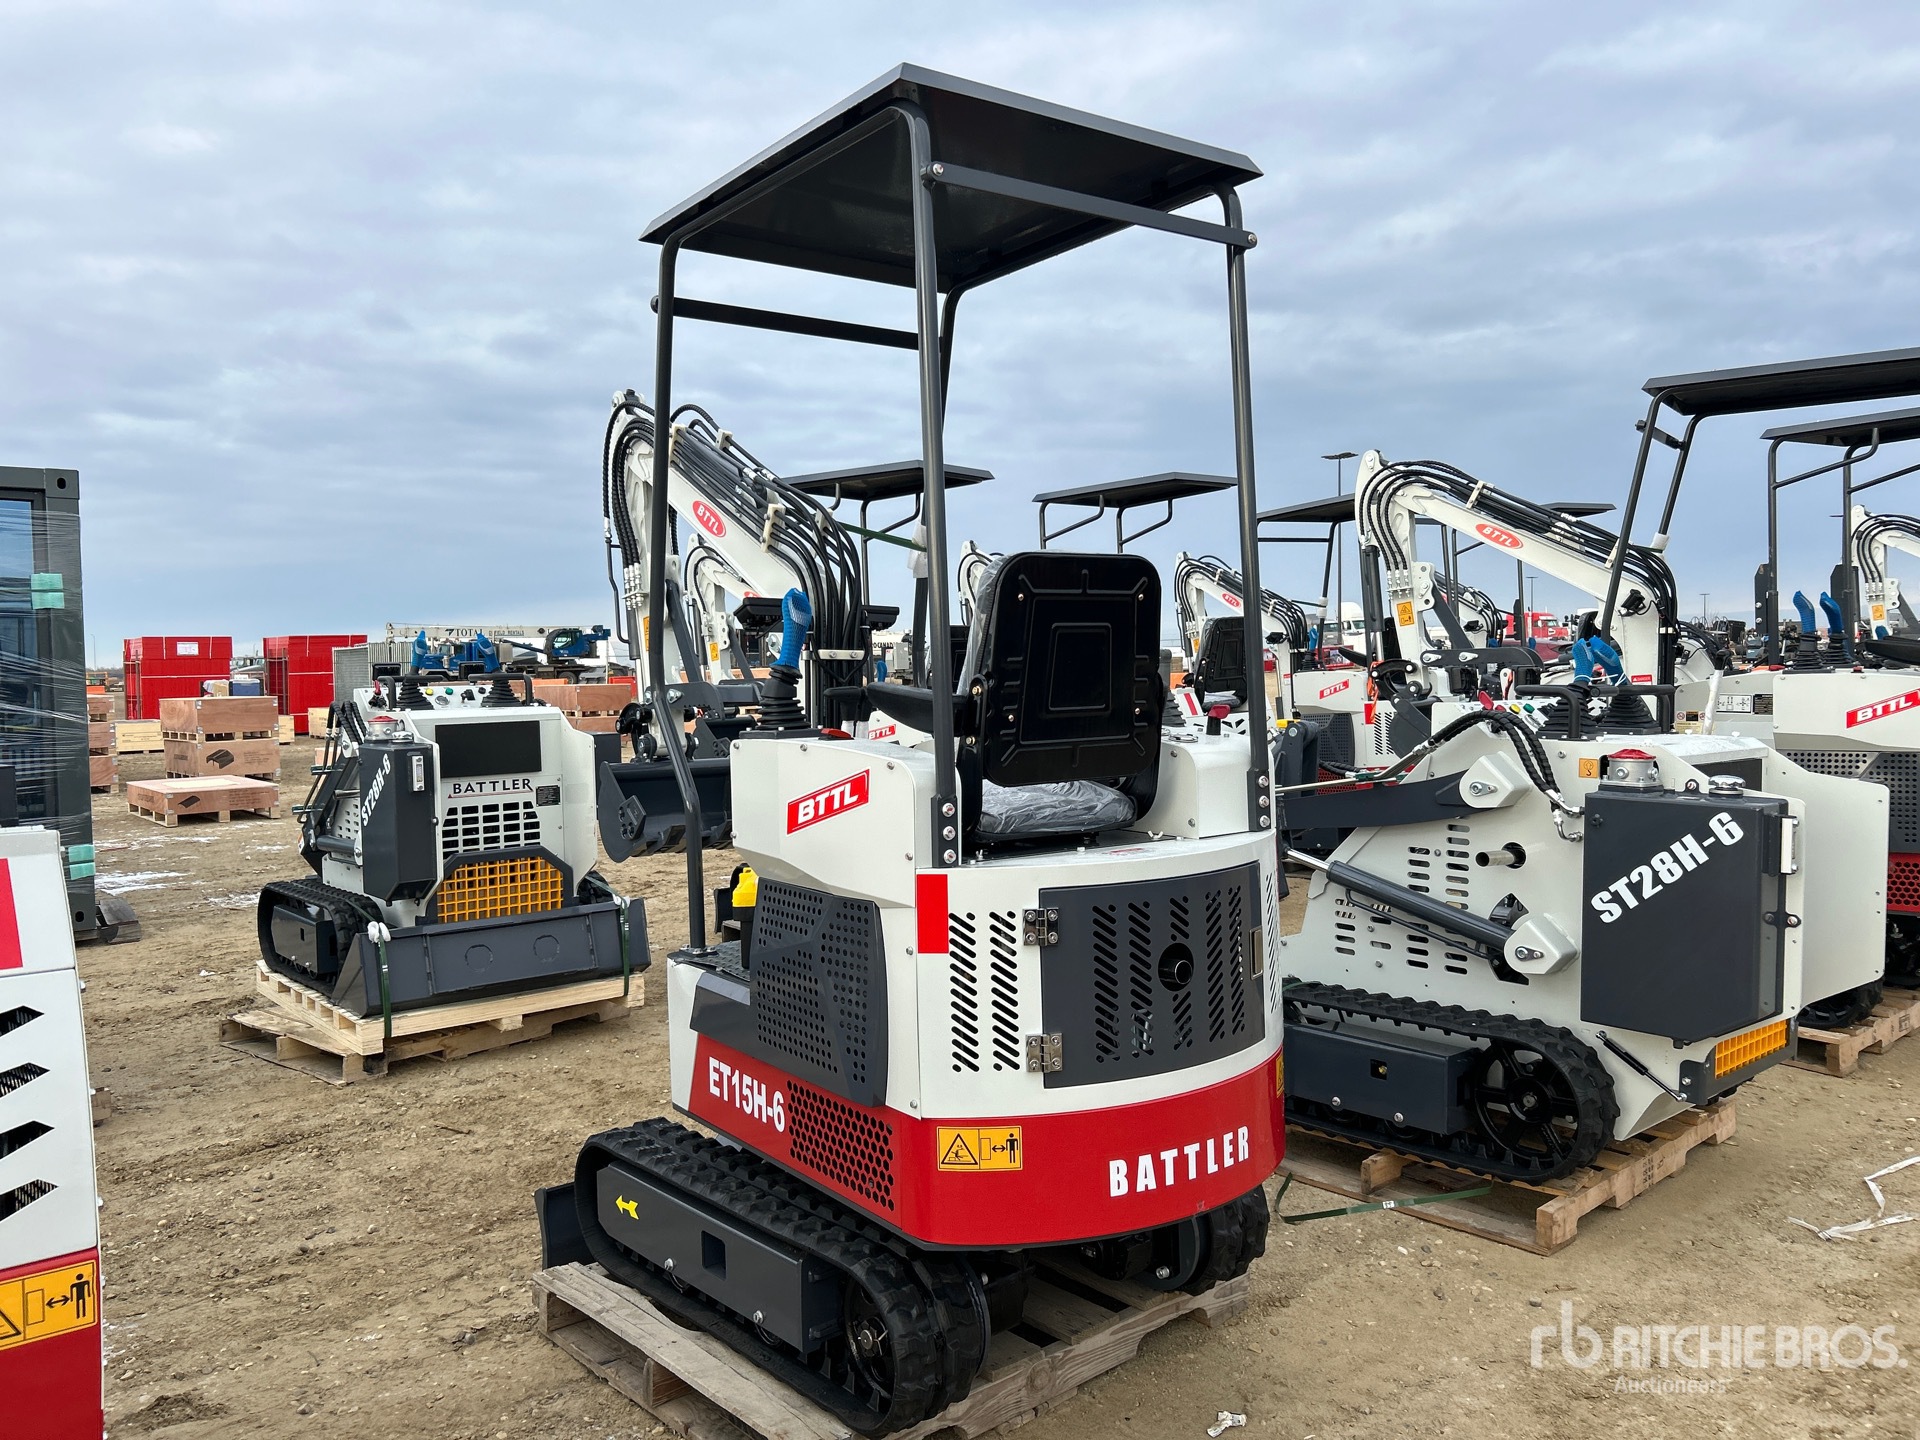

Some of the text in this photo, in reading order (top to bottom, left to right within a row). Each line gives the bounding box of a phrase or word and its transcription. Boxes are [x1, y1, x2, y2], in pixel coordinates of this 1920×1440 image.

[697, 504, 719, 534] BTTL
[1482, 526, 1513, 548] BTTL
[1224, 594, 1239, 607] BTTL
[1323, 682, 1346, 696] BTTL
[1857, 695, 1913, 723] BTTL
[869, 728, 892, 739] BTTL
[361, 753, 391, 827] ST28H-6
[453, 778, 532, 795] BATTLER
[798, 782, 859, 824] BTTL
[1591, 812, 1744, 923] ST28H-6
[709, 1056, 785, 1132] ET15H-6
[1109, 1125, 1249, 1197] BATTLER
